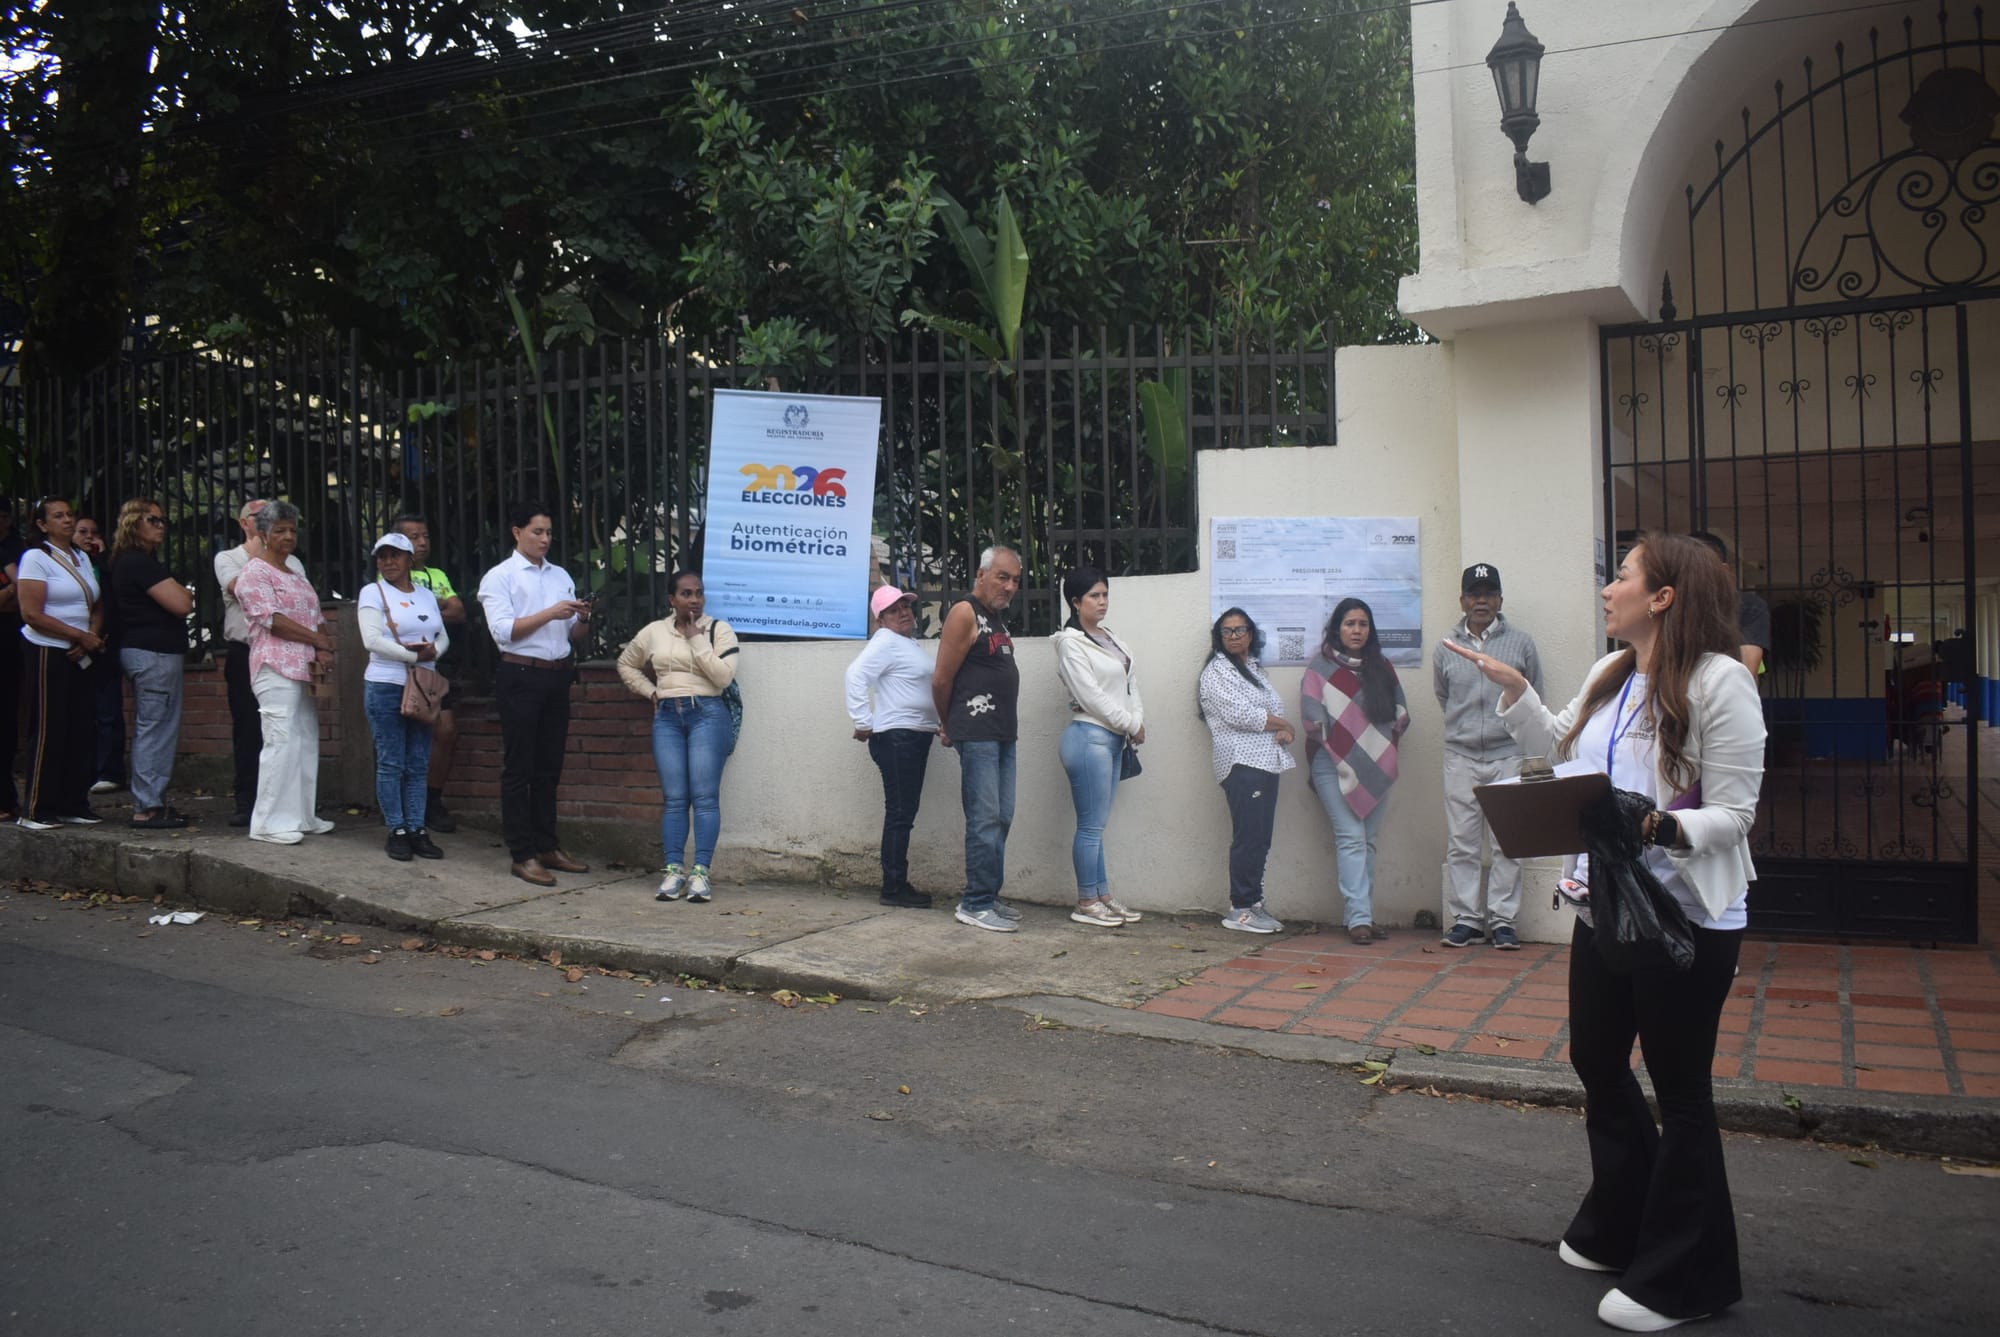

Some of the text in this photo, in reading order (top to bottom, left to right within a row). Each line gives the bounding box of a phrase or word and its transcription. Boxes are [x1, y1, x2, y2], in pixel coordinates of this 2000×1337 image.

[739, 463, 847, 496] 2026
[741, 490, 846, 508] ELECCIONES
[732, 522, 848, 540] Autenticación
[731, 535, 847, 556] biométrica
[727, 616, 841, 629] www.registraduria.gov.co
